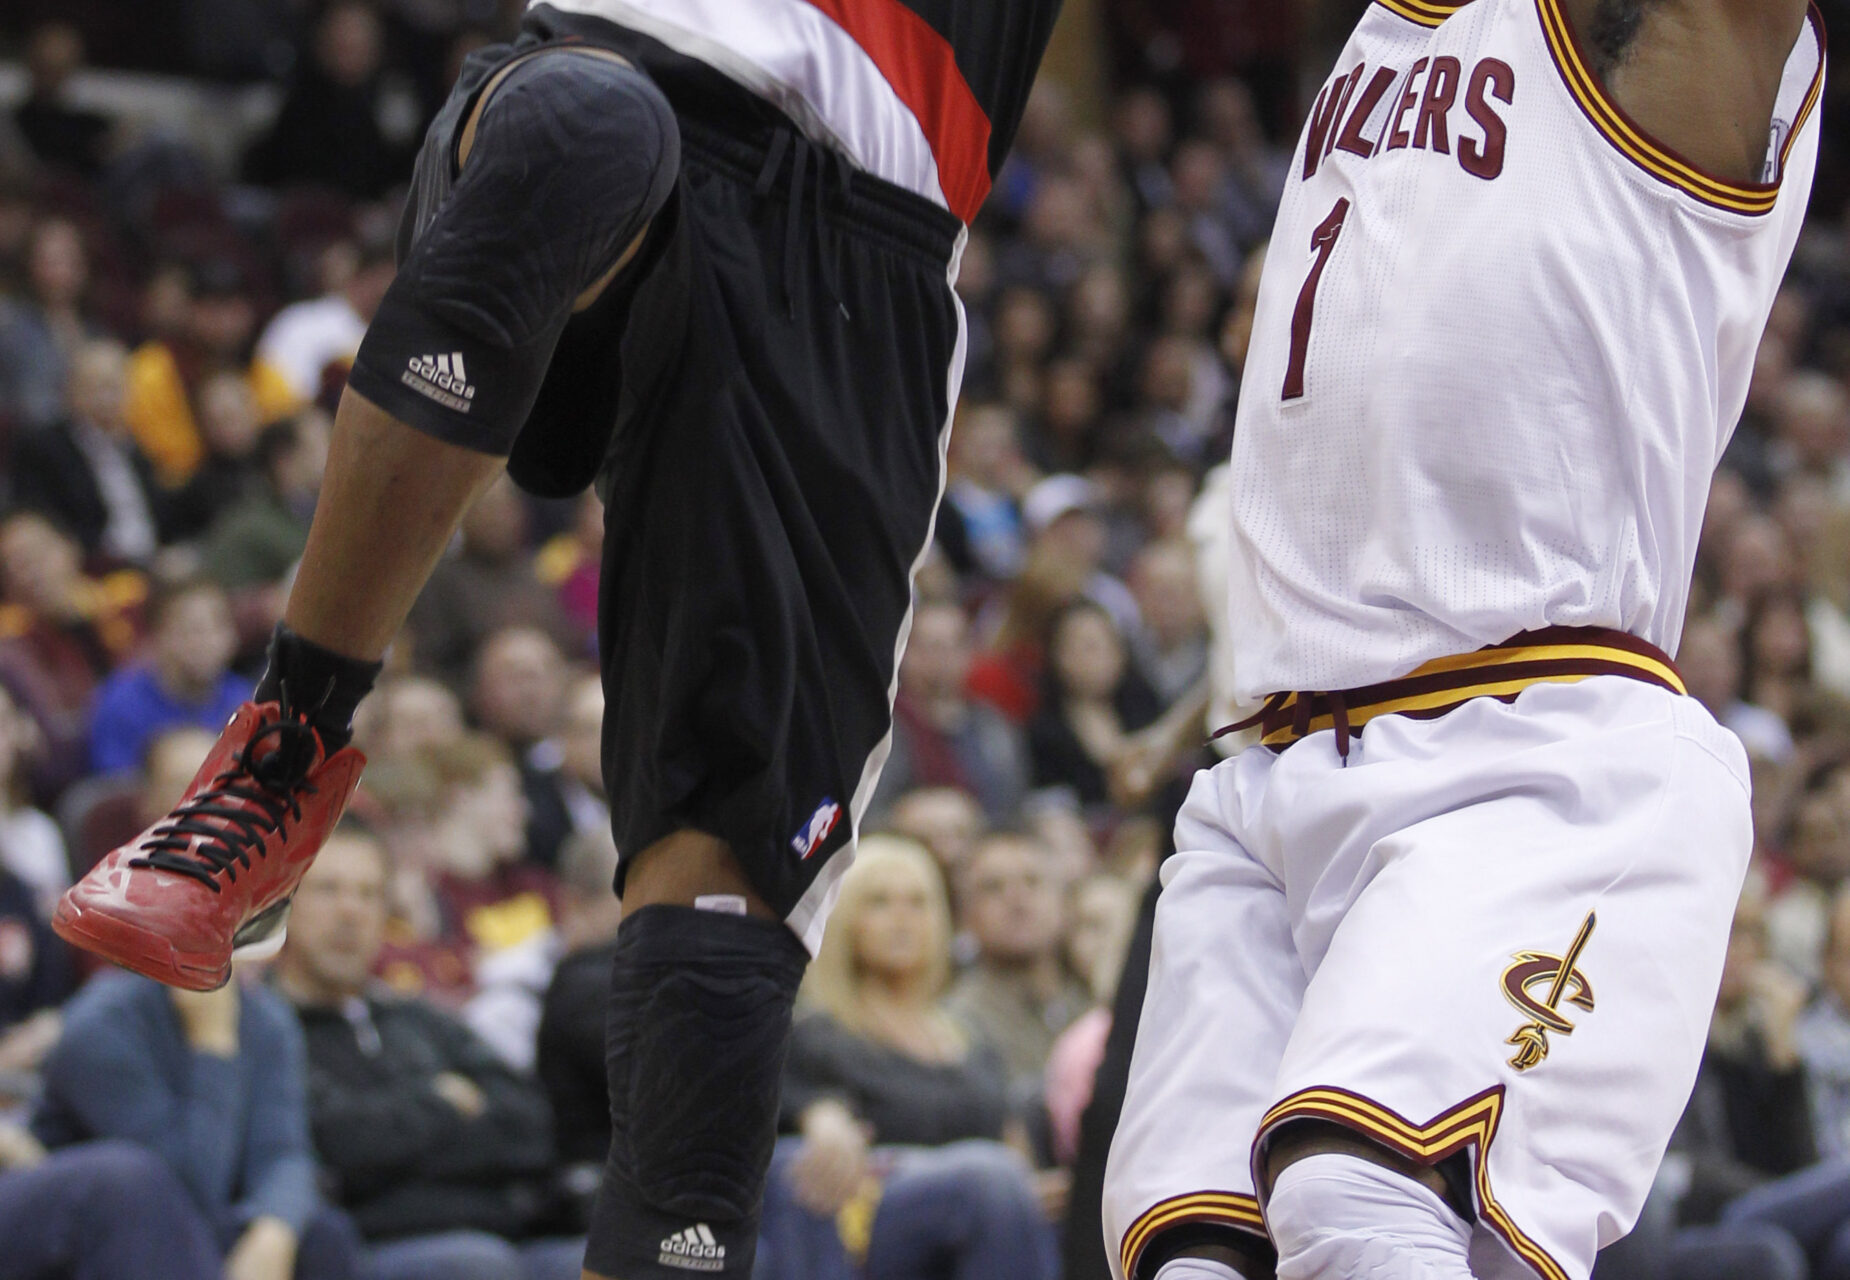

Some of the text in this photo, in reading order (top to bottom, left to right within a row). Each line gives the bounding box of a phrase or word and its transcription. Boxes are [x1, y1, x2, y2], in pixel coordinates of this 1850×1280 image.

[1281, 197, 1350, 402] 1
[408, 356, 476, 400] adidas
[660, 1238, 726, 1259] adidas
